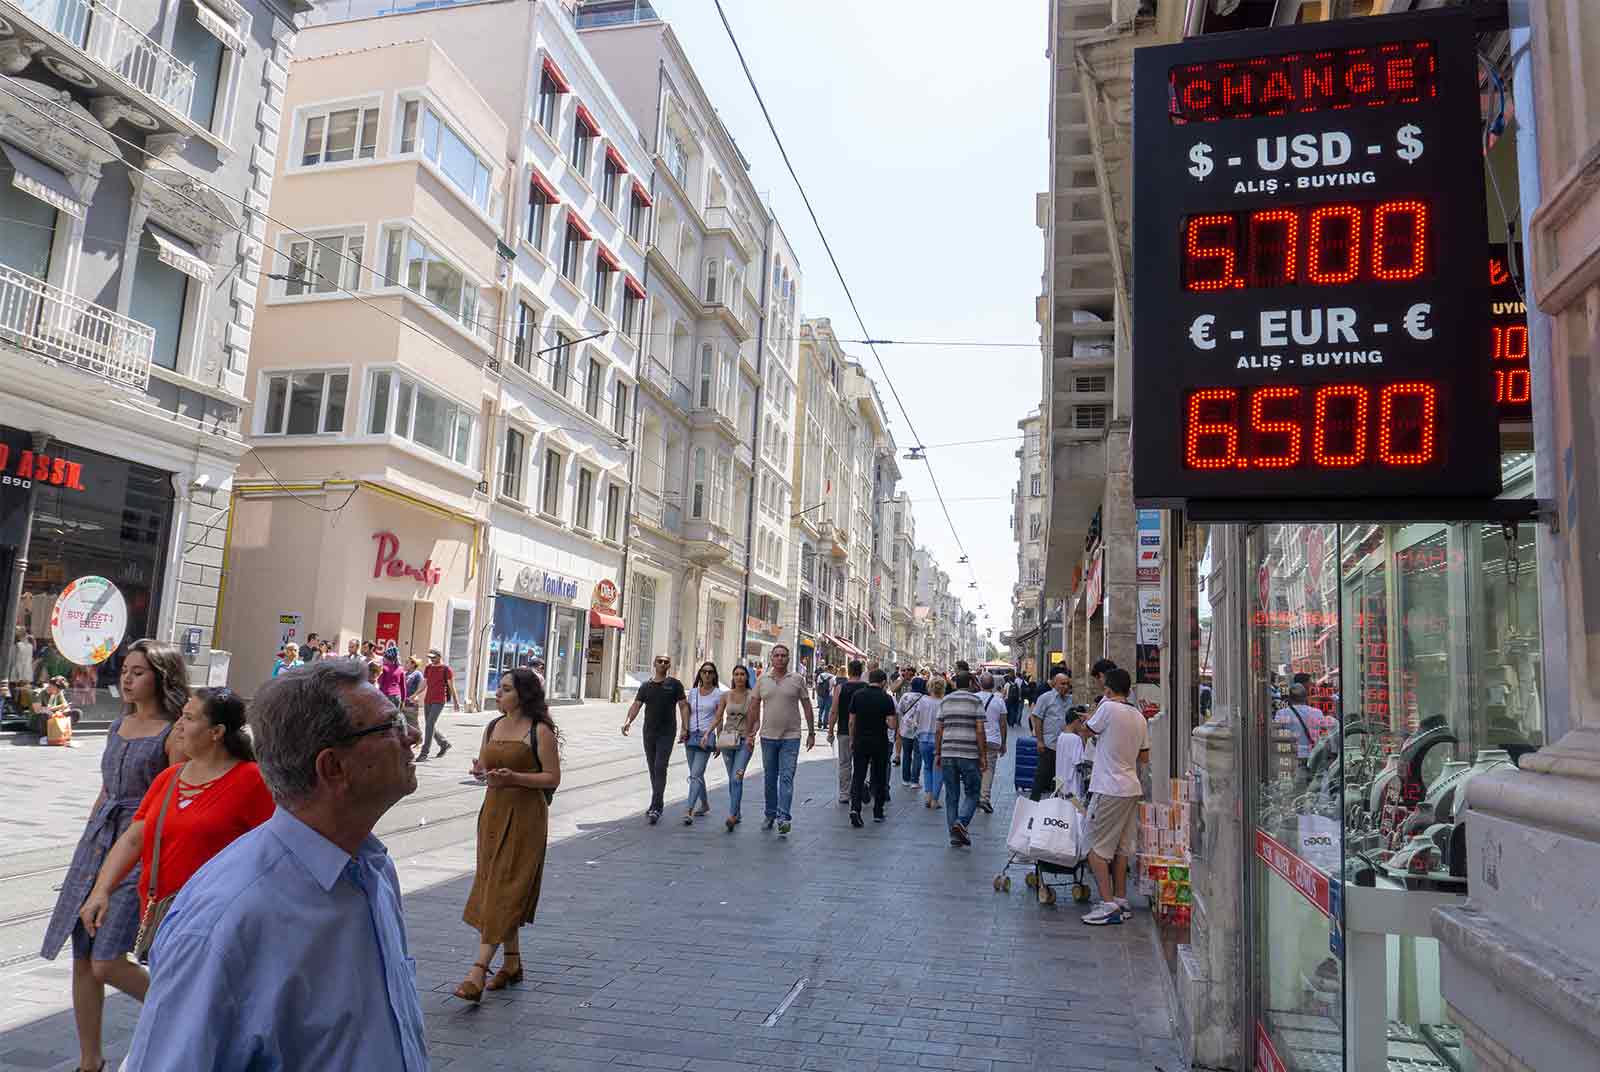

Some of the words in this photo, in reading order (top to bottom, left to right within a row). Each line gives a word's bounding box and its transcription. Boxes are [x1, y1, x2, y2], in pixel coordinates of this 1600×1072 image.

[1183, 57, 1414, 109] CHANGE
[1188, 141, 1214, 182] $
[1257, 131, 1352, 171] USD
[1396, 123, 1424, 165] $
[1233, 178, 1278, 195] ALIŞ
[1297, 171, 1376, 189] BUYING
[1188, 200, 1426, 291] 5.700
[1188, 314, 1217, 350] €
[1260, 307, 1360, 347] EUR
[1402, 303, 1433, 340] €
[1236, 354, 1282, 371] ALIŞ
[1301, 350, 1383, 366] BUYING
[1186, 383, 1435, 469] 6.500
